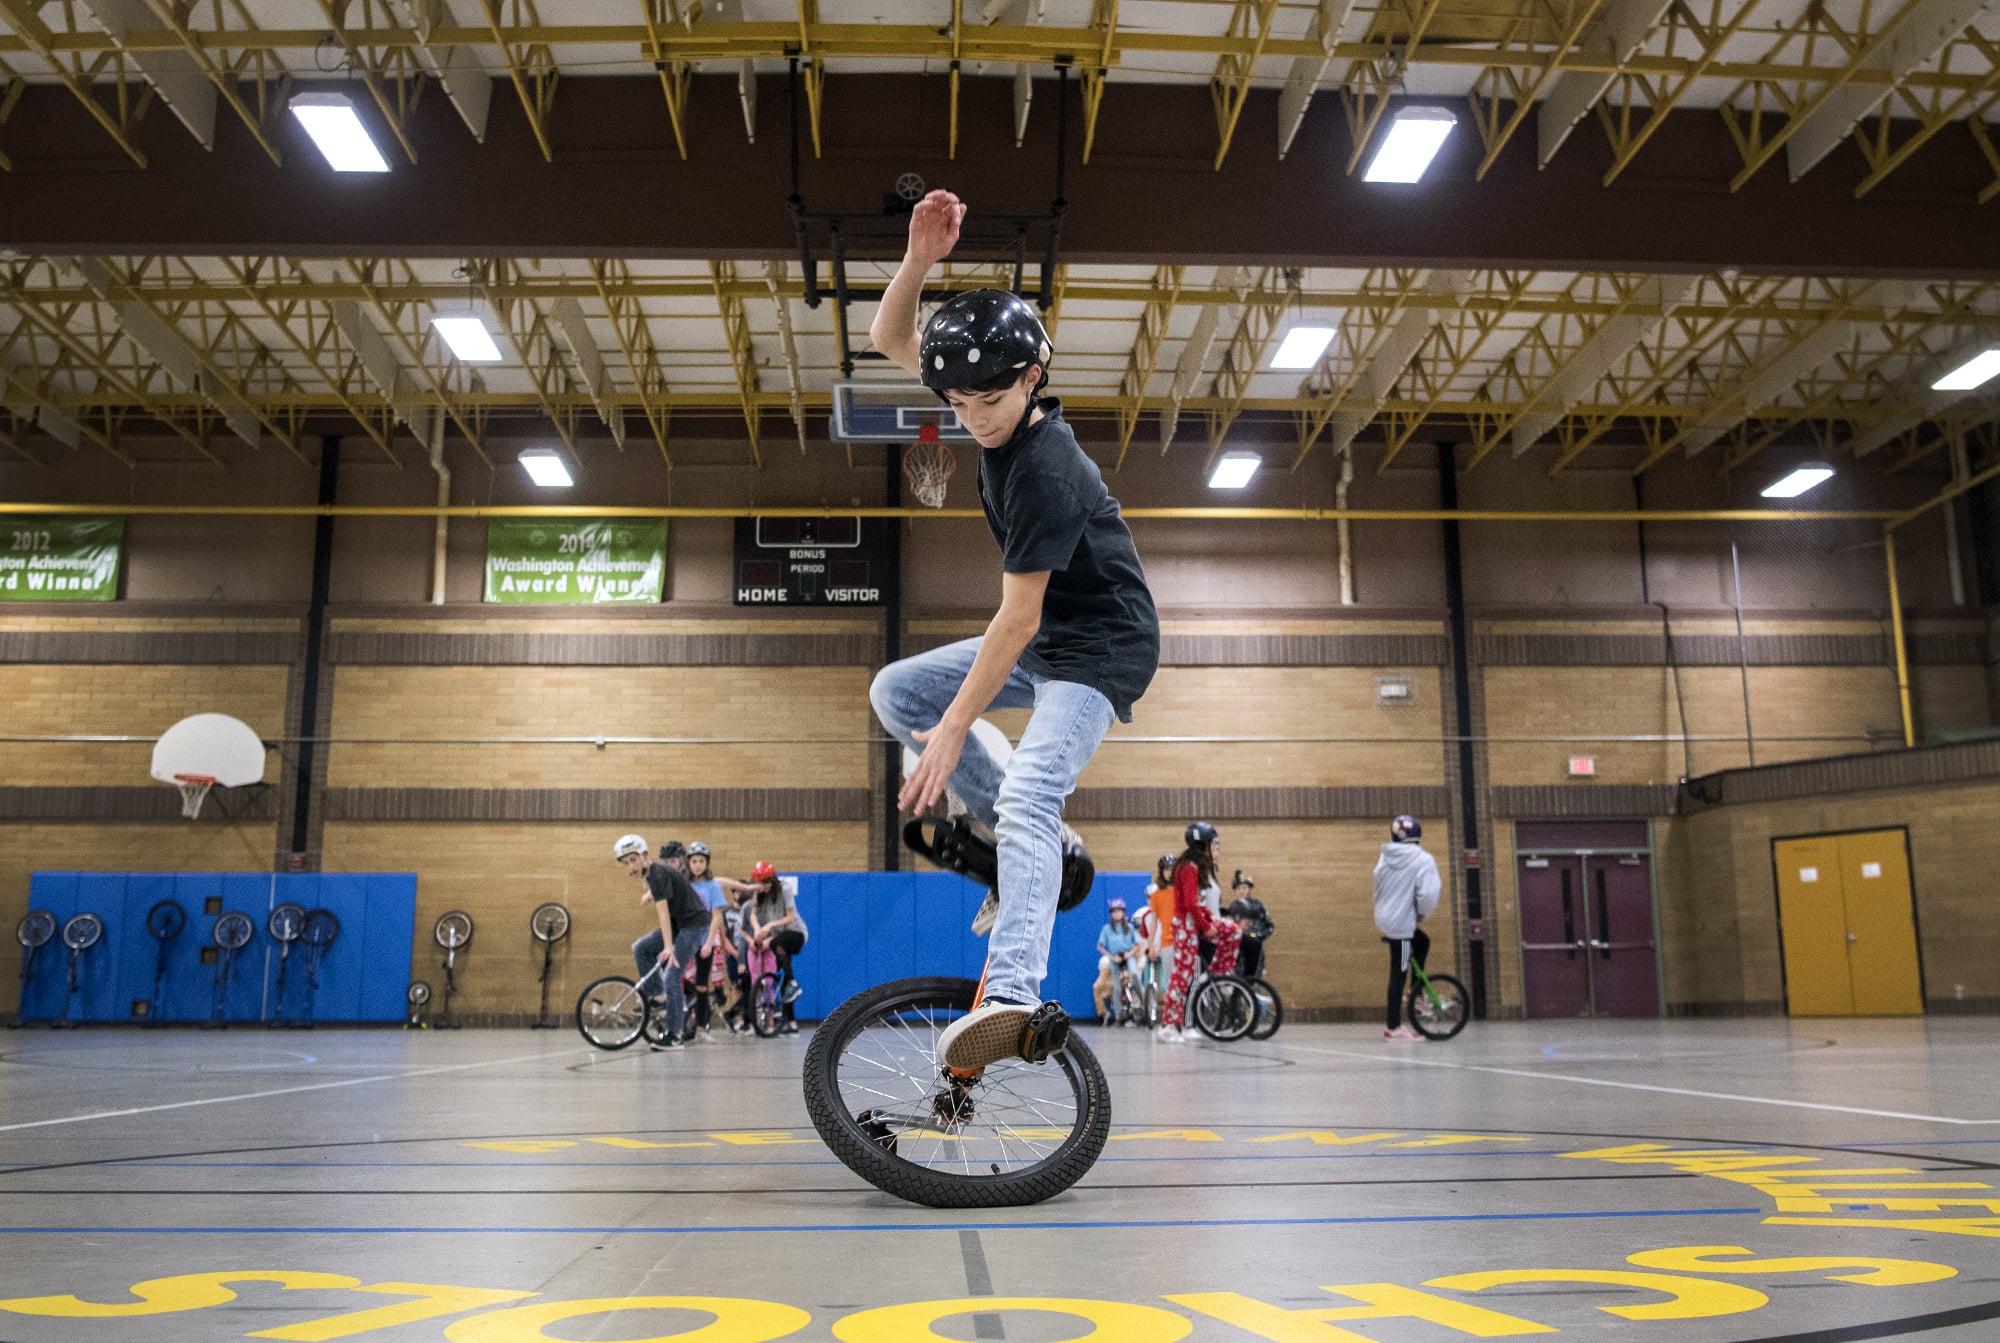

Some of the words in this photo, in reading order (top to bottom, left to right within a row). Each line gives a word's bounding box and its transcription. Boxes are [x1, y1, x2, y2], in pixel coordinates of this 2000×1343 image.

[11, 531, 51, 552] 2012
[789, 549, 826, 559] BONUS
[493, 557, 574, 575] Washington
[790, 564, 825, 574] PERIOD
[500, 574, 568, 593] Award
[738, 588, 788, 602] HOME
[825, 588, 880, 602] VISITOR
[1084, 1068, 1097, 1104] KENDA
